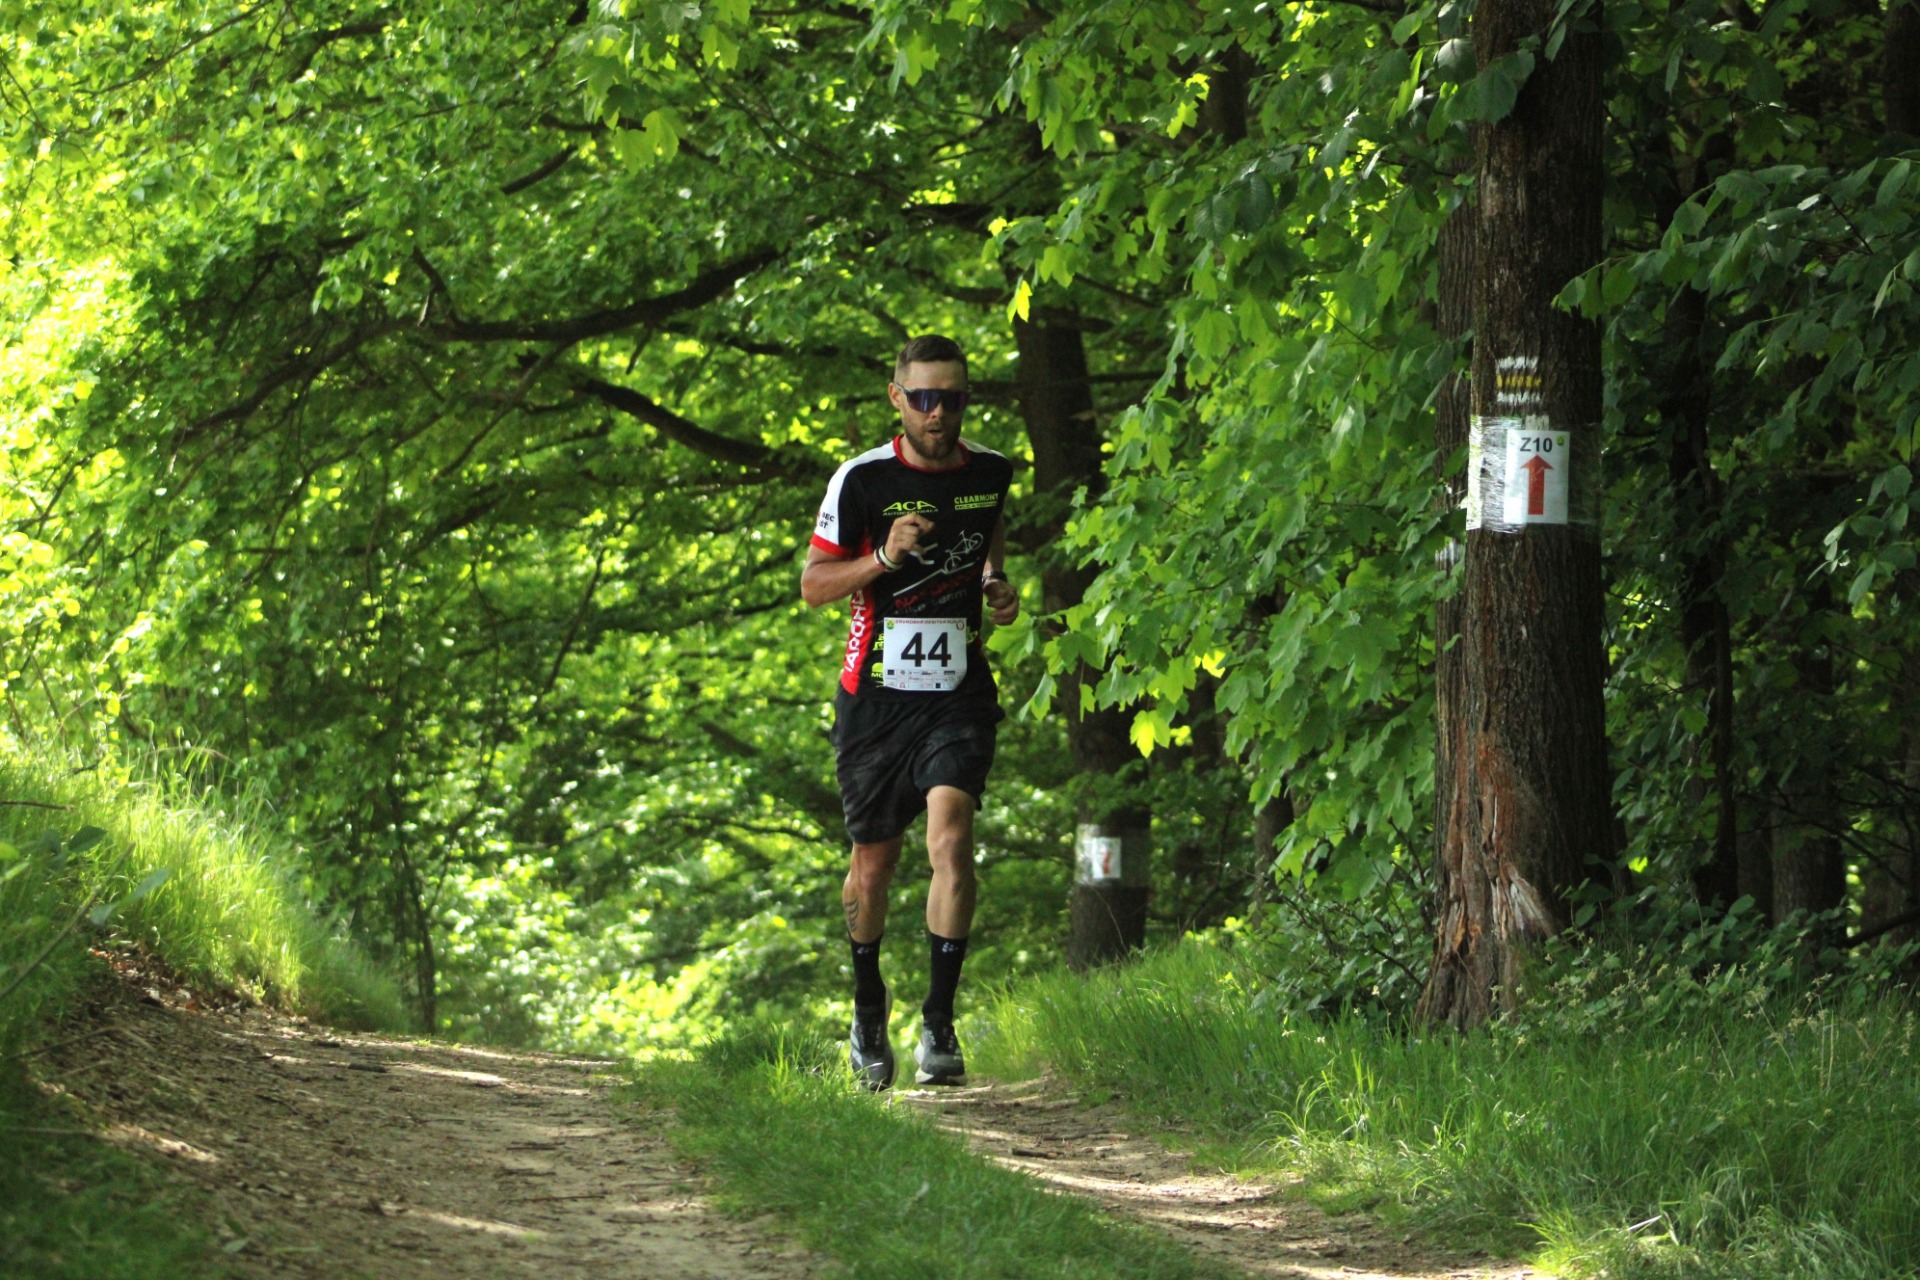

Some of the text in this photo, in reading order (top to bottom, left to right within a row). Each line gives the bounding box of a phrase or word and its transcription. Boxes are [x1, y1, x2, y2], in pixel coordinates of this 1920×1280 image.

[1520, 437, 1553, 453] Z10
[954, 493, 999, 504] CLEARMONT
[882, 500, 936, 512] ACA
[901, 632, 952, 668] 44
